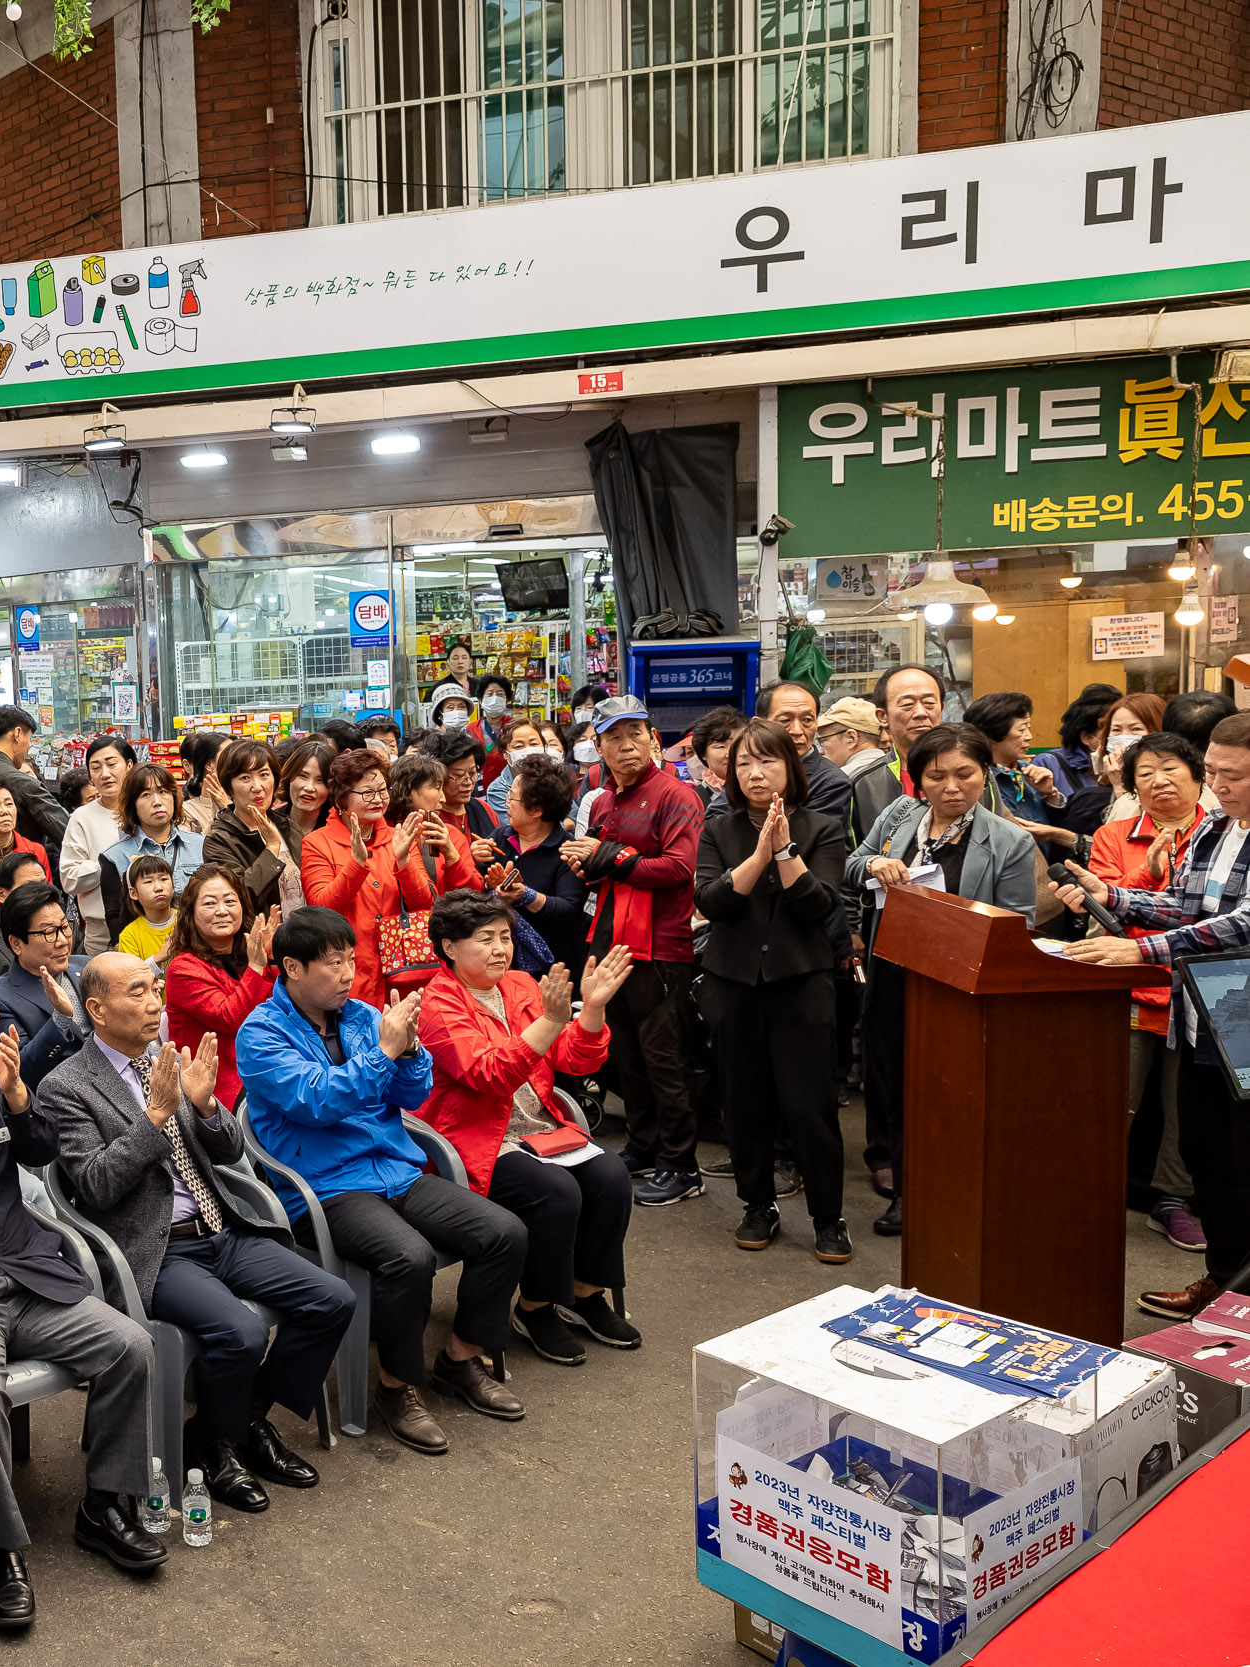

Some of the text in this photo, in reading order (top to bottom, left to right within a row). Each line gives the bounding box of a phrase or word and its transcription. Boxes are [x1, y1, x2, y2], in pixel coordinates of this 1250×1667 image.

[245, 283, 298, 308] 상품의
[382, 269, 417, 293] 뭐든
[429, 270, 446, 283] 다
[456, 258, 535, 283] 있어요!!
[589, 374, 607, 389] 15
[802, 386, 1108, 486] 우리마트
[993, 479, 1250, 532] 배송문의. 455
[358, 604, 387, 620] 담배
[652, 668, 732, 684] 은행공동 365 코너
[1131, 1384, 1174, 1421] CUCKOO
[754, 1470, 892, 1542] 2023년 자양전통시장
[777, 1498, 867, 1551] 맥주 페스티벌
[989, 1479, 1076, 1537] 2023년 자양전통시장
[1005, 1505, 1061, 1547] 맥주 페스티벌
[729, 1498, 893, 1594] 경품권응모함
[972, 1521, 1076, 1600] 경품권응모함
[736, 1533, 885, 1613] 행사장에 계신 고객에 한하여 추첨해서
[775, 1563, 840, 1601] 상품을 드립니다.
[976, 1602, 998, 1621] 행사장에
